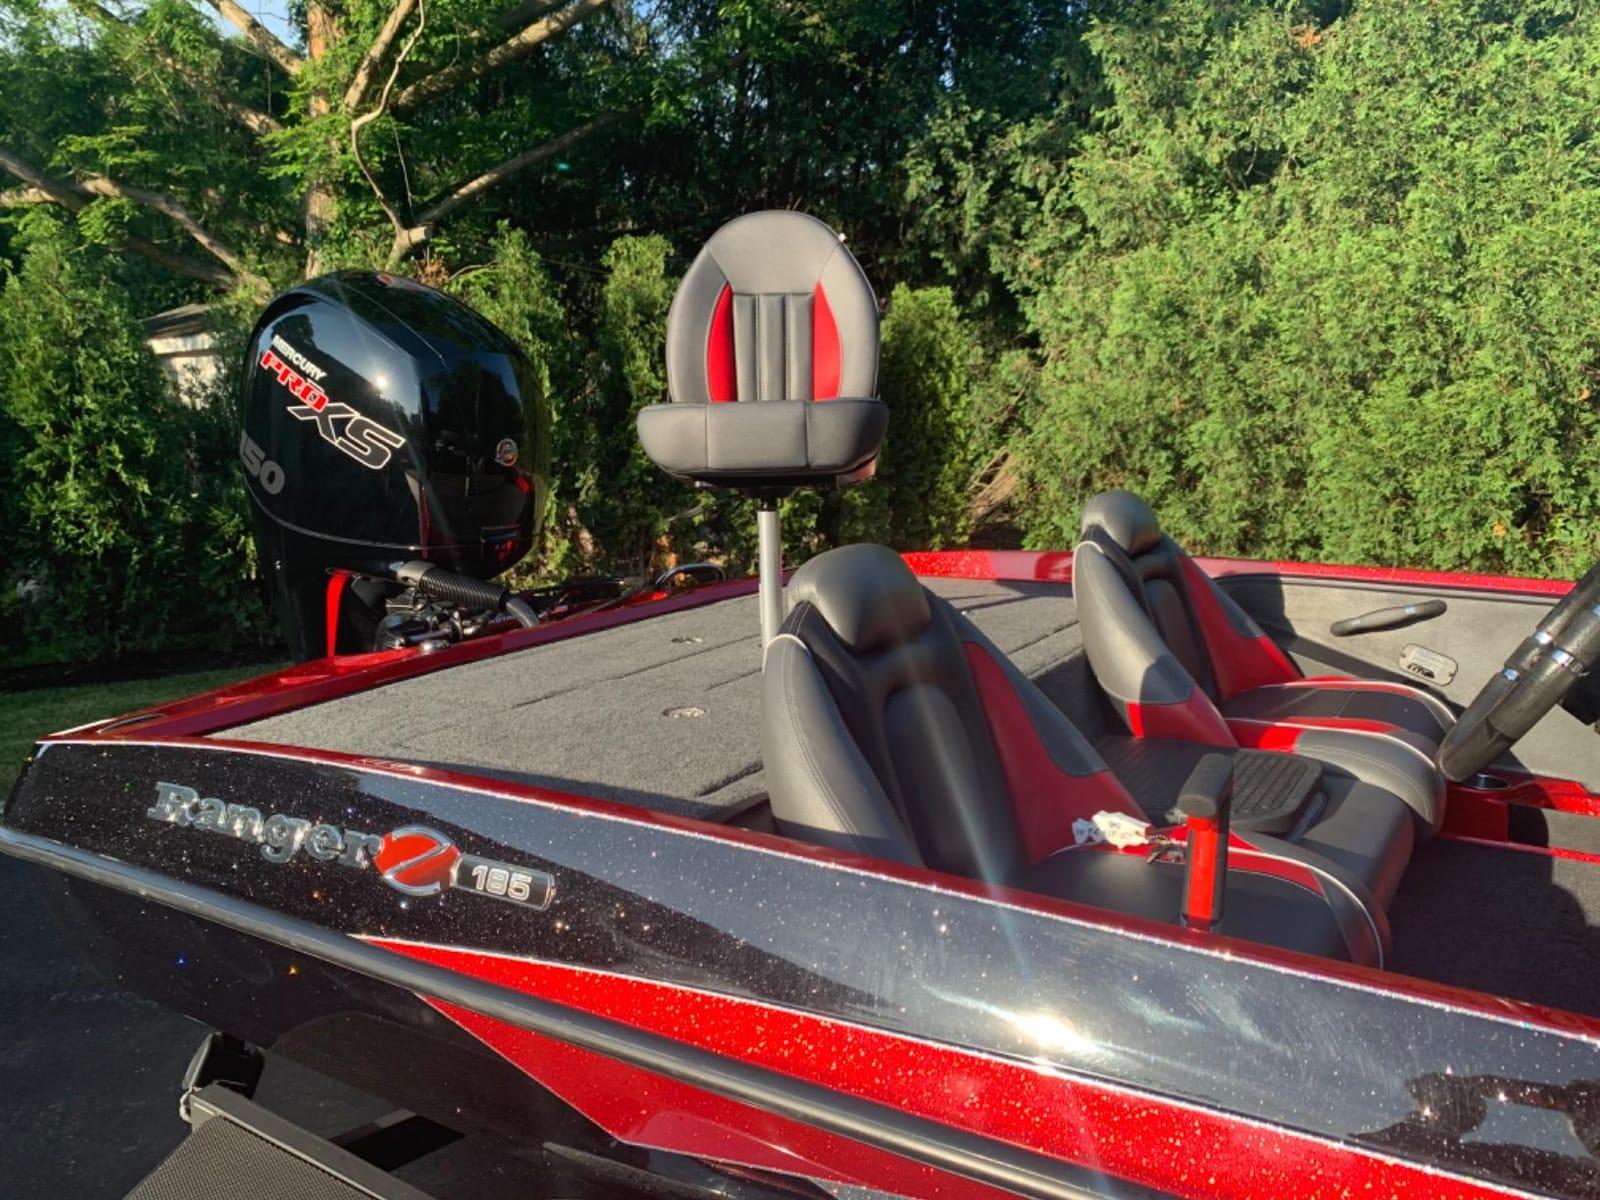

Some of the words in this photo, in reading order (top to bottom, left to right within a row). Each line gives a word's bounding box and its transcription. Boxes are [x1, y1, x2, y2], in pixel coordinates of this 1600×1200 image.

[260, 349, 329, 413] PRO
[271, 334, 328, 380] MERCURY
[287, 402, 406, 470] XS
[147, 781, 382, 869] Ranger
[472, 865, 532, 901] 185
